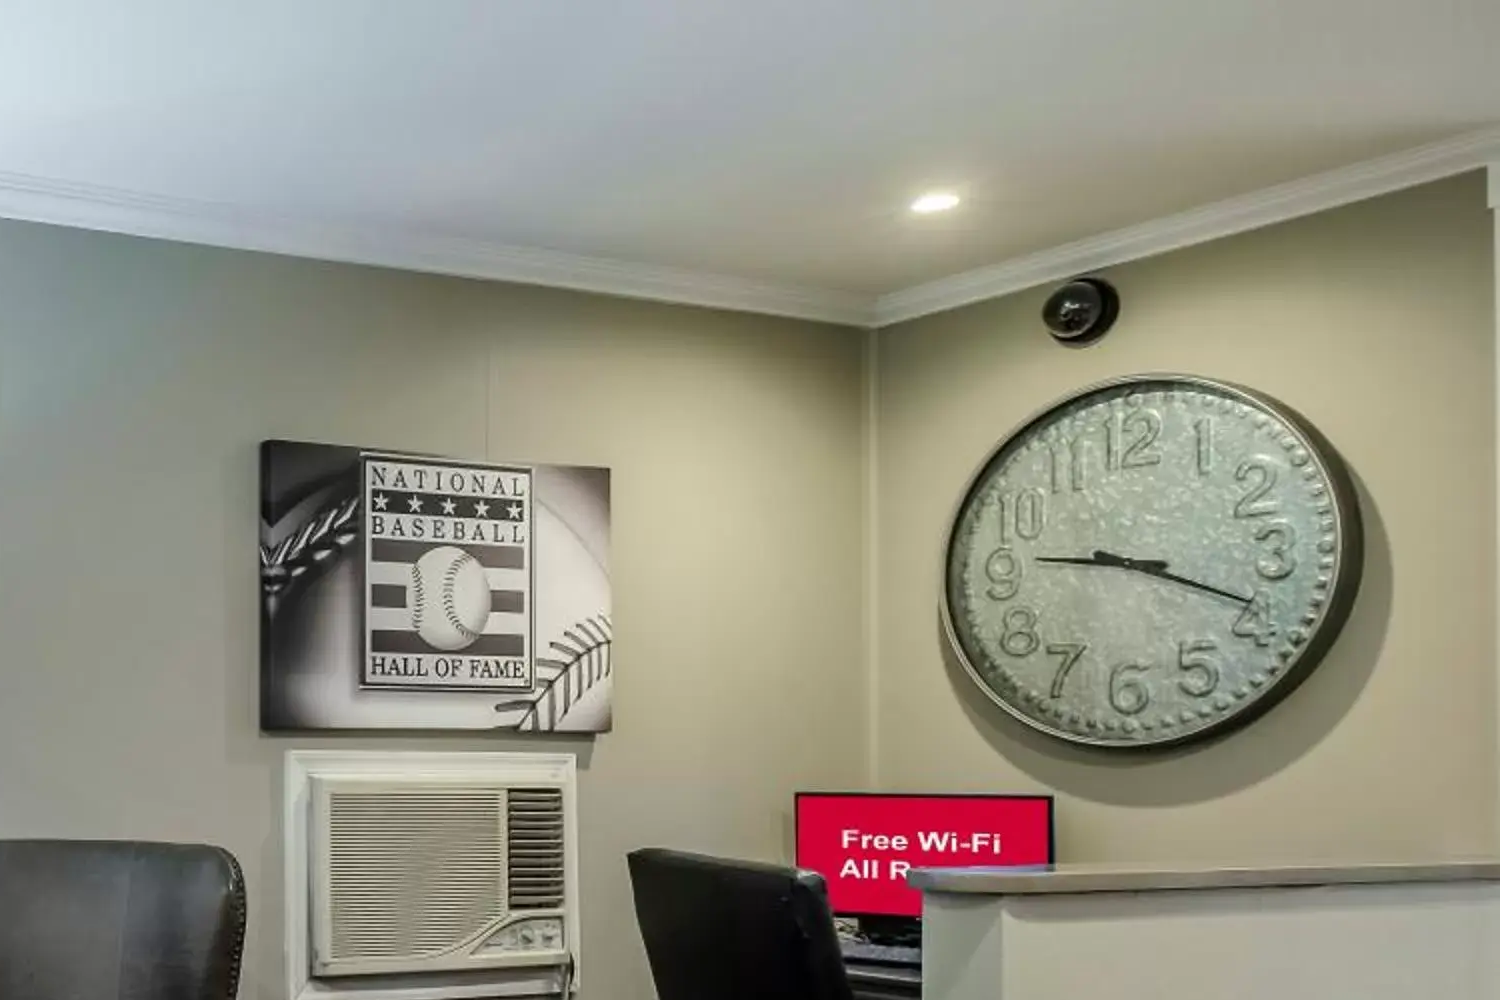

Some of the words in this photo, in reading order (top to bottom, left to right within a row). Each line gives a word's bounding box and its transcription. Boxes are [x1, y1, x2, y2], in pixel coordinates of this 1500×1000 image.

[1050, 435, 1088, 494] 11
[1104, 407, 1162, 471] 12
[1193, 418, 1214, 476] 1
[371, 465, 525, 497] NATIONAL
[1233, 455, 1279, 519] 2
[371, 515, 525, 542] BASEBALL
[998, 487, 1046, 544] 10
[985, 547, 1023, 600] 9
[1255, 520, 1297, 580] 3
[1001, 606, 1040, 657] 8
[1231, 589, 1277, 647] 4
[371, 656, 429, 677] HALL
[435, 658, 465, 679] OF
[469, 660, 525, 679] FAME
[1046, 642, 1088, 699] 7
[1109, 663, 1151, 716] 6
[1178, 638, 1220, 698] 5
[839, 860, 879, 879] All
[842, 829, 908, 851] Free
[917, 831, 1001, 854] Wi-Fi
